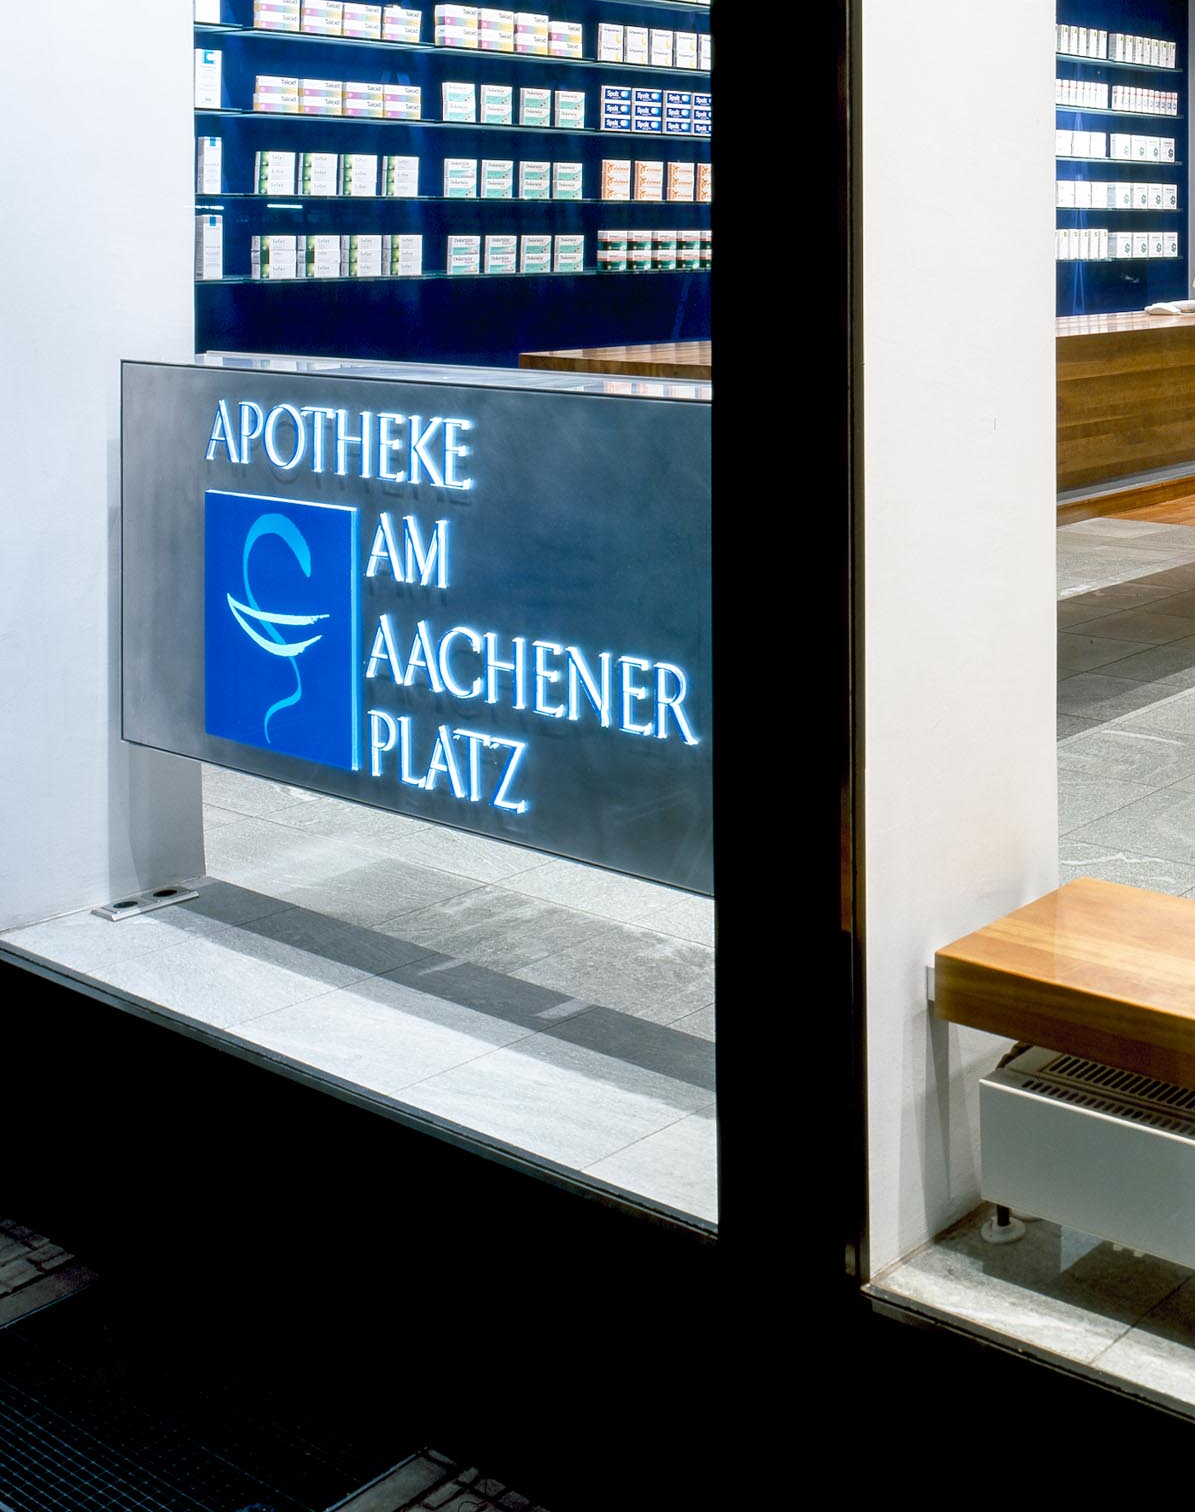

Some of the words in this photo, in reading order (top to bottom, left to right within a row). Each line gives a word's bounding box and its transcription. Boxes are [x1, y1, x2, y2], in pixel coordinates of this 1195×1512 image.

[205, 399, 473, 490] APOTHEKE
[366, 512, 449, 590] AM
[366, 614, 699, 746] AACHENER
[368, 709, 528, 814] PLATZ
